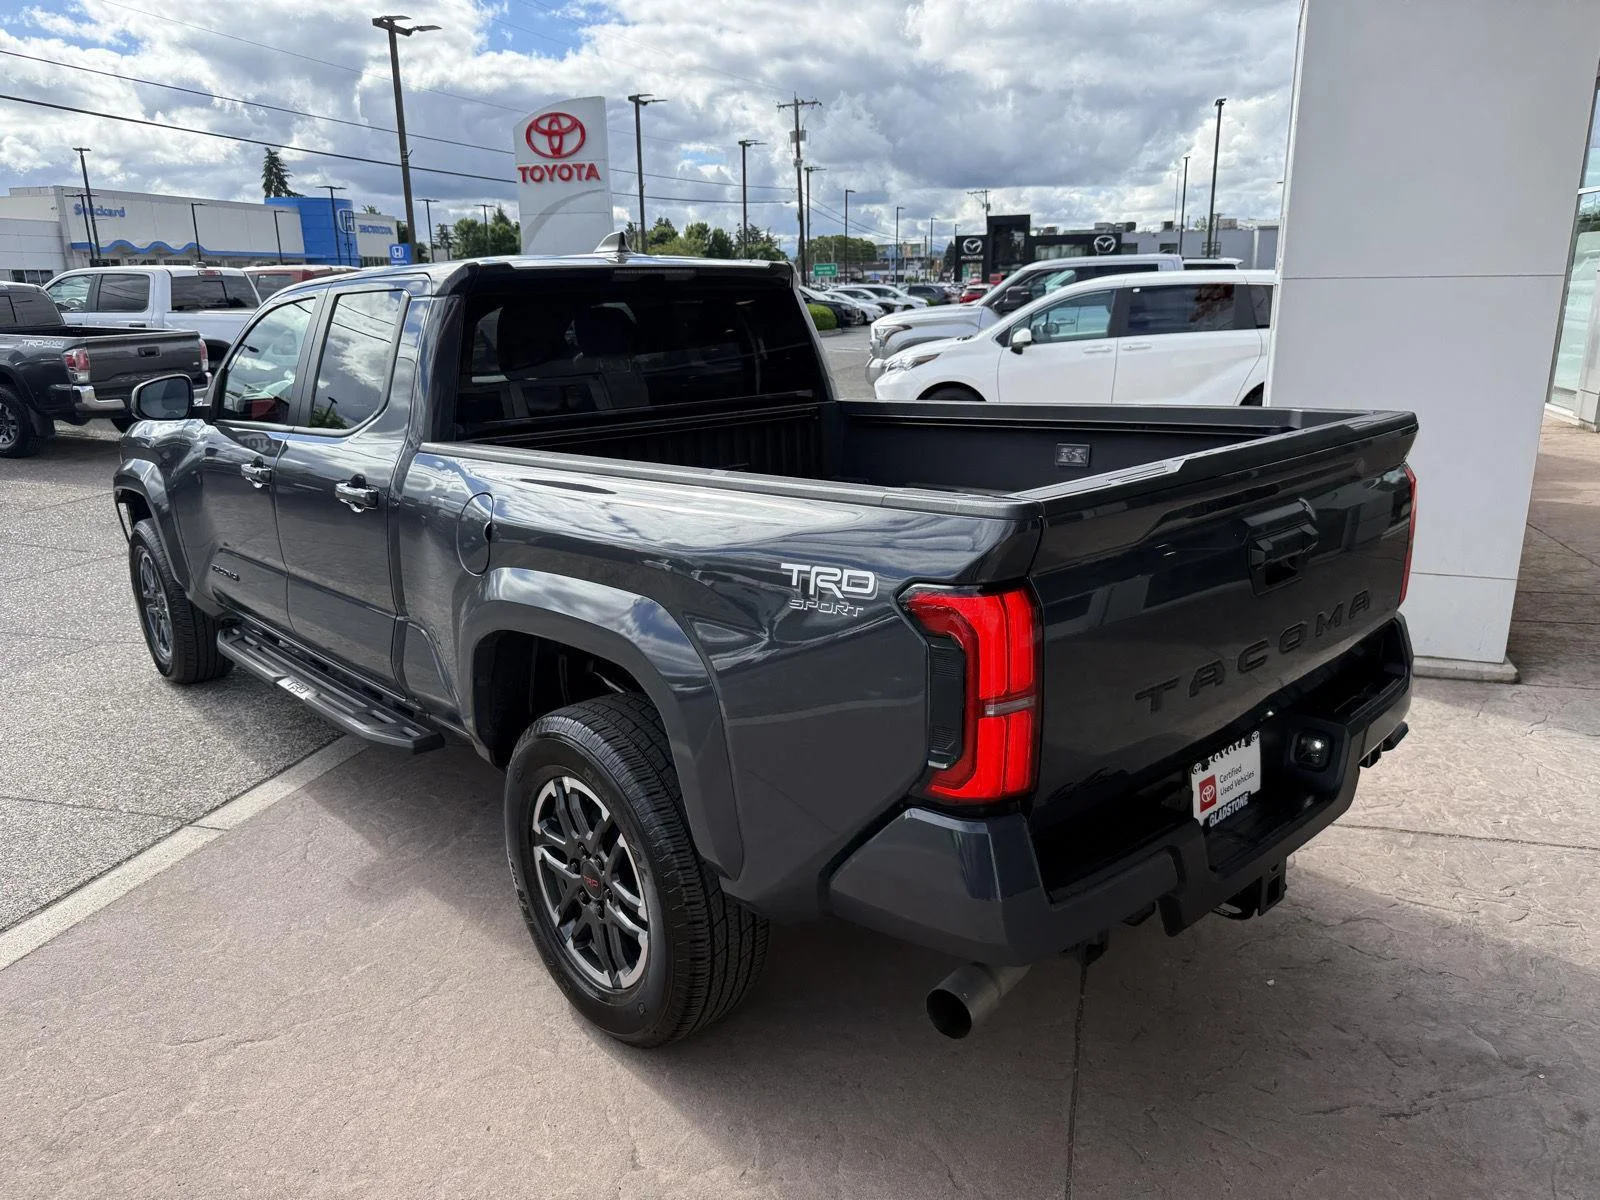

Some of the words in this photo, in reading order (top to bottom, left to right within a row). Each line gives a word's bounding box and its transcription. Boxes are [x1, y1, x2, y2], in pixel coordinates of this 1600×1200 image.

[517, 162, 601, 184] TOYOTA
[781, 562, 876, 599] TRD
[788, 599, 864, 617] SPORT
[1134, 589, 1371, 713] TACOMA
[1207, 737, 1246, 766] TOYOTA
[1219, 763, 1242, 783] Certified
[1220, 781, 1234, 796] Used
[1234, 770, 1255, 789] Vehicles
[1209, 793, 1249, 828] GLADSTONE
